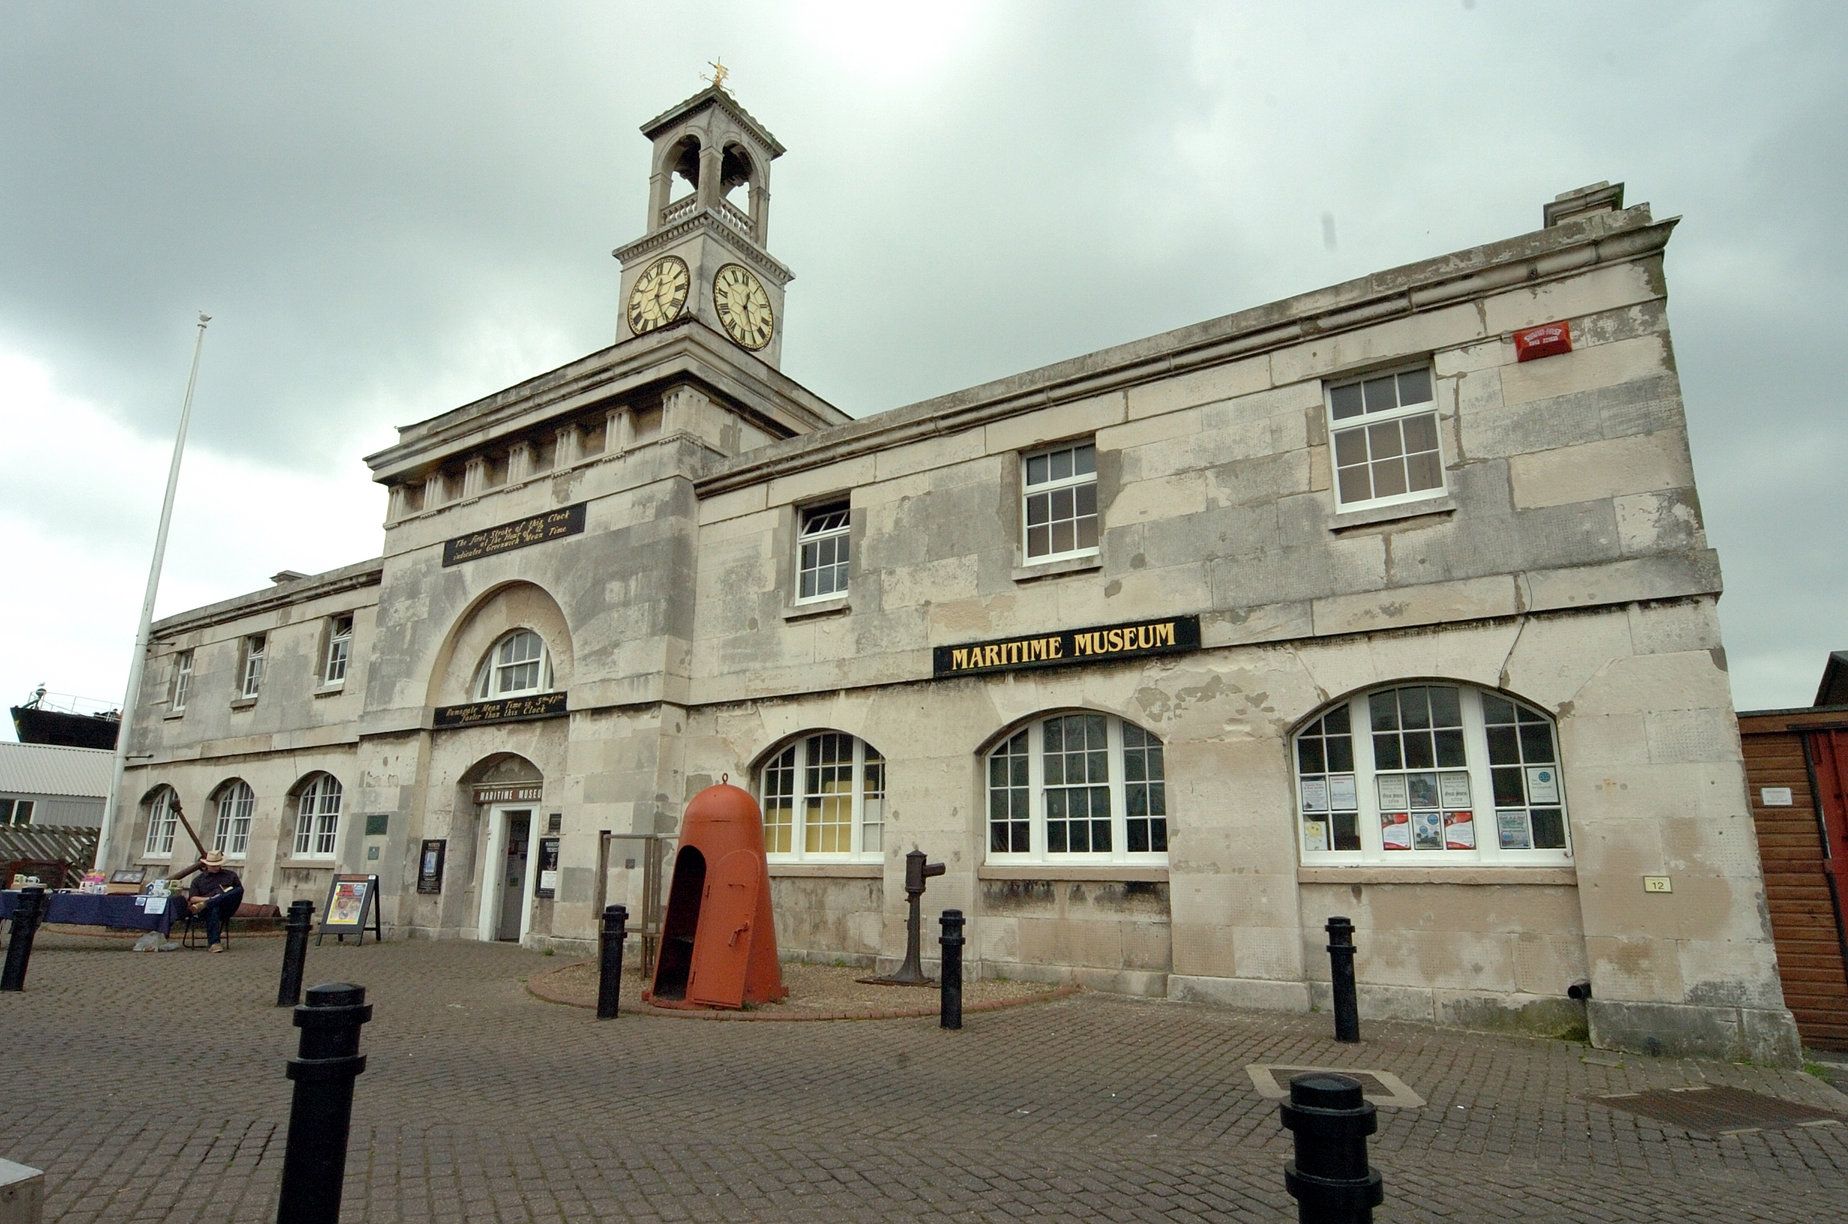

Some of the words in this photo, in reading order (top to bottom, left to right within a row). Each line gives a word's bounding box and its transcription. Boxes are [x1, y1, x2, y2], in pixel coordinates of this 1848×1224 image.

[547, 510, 569, 522] Clock
[952, 637, 1063, 670] MARITIME
[1074, 622, 1176, 657] MUSEUM
[480, 790, 513, 800] MARITIME
[519, 789, 542, 799] MUSEU
